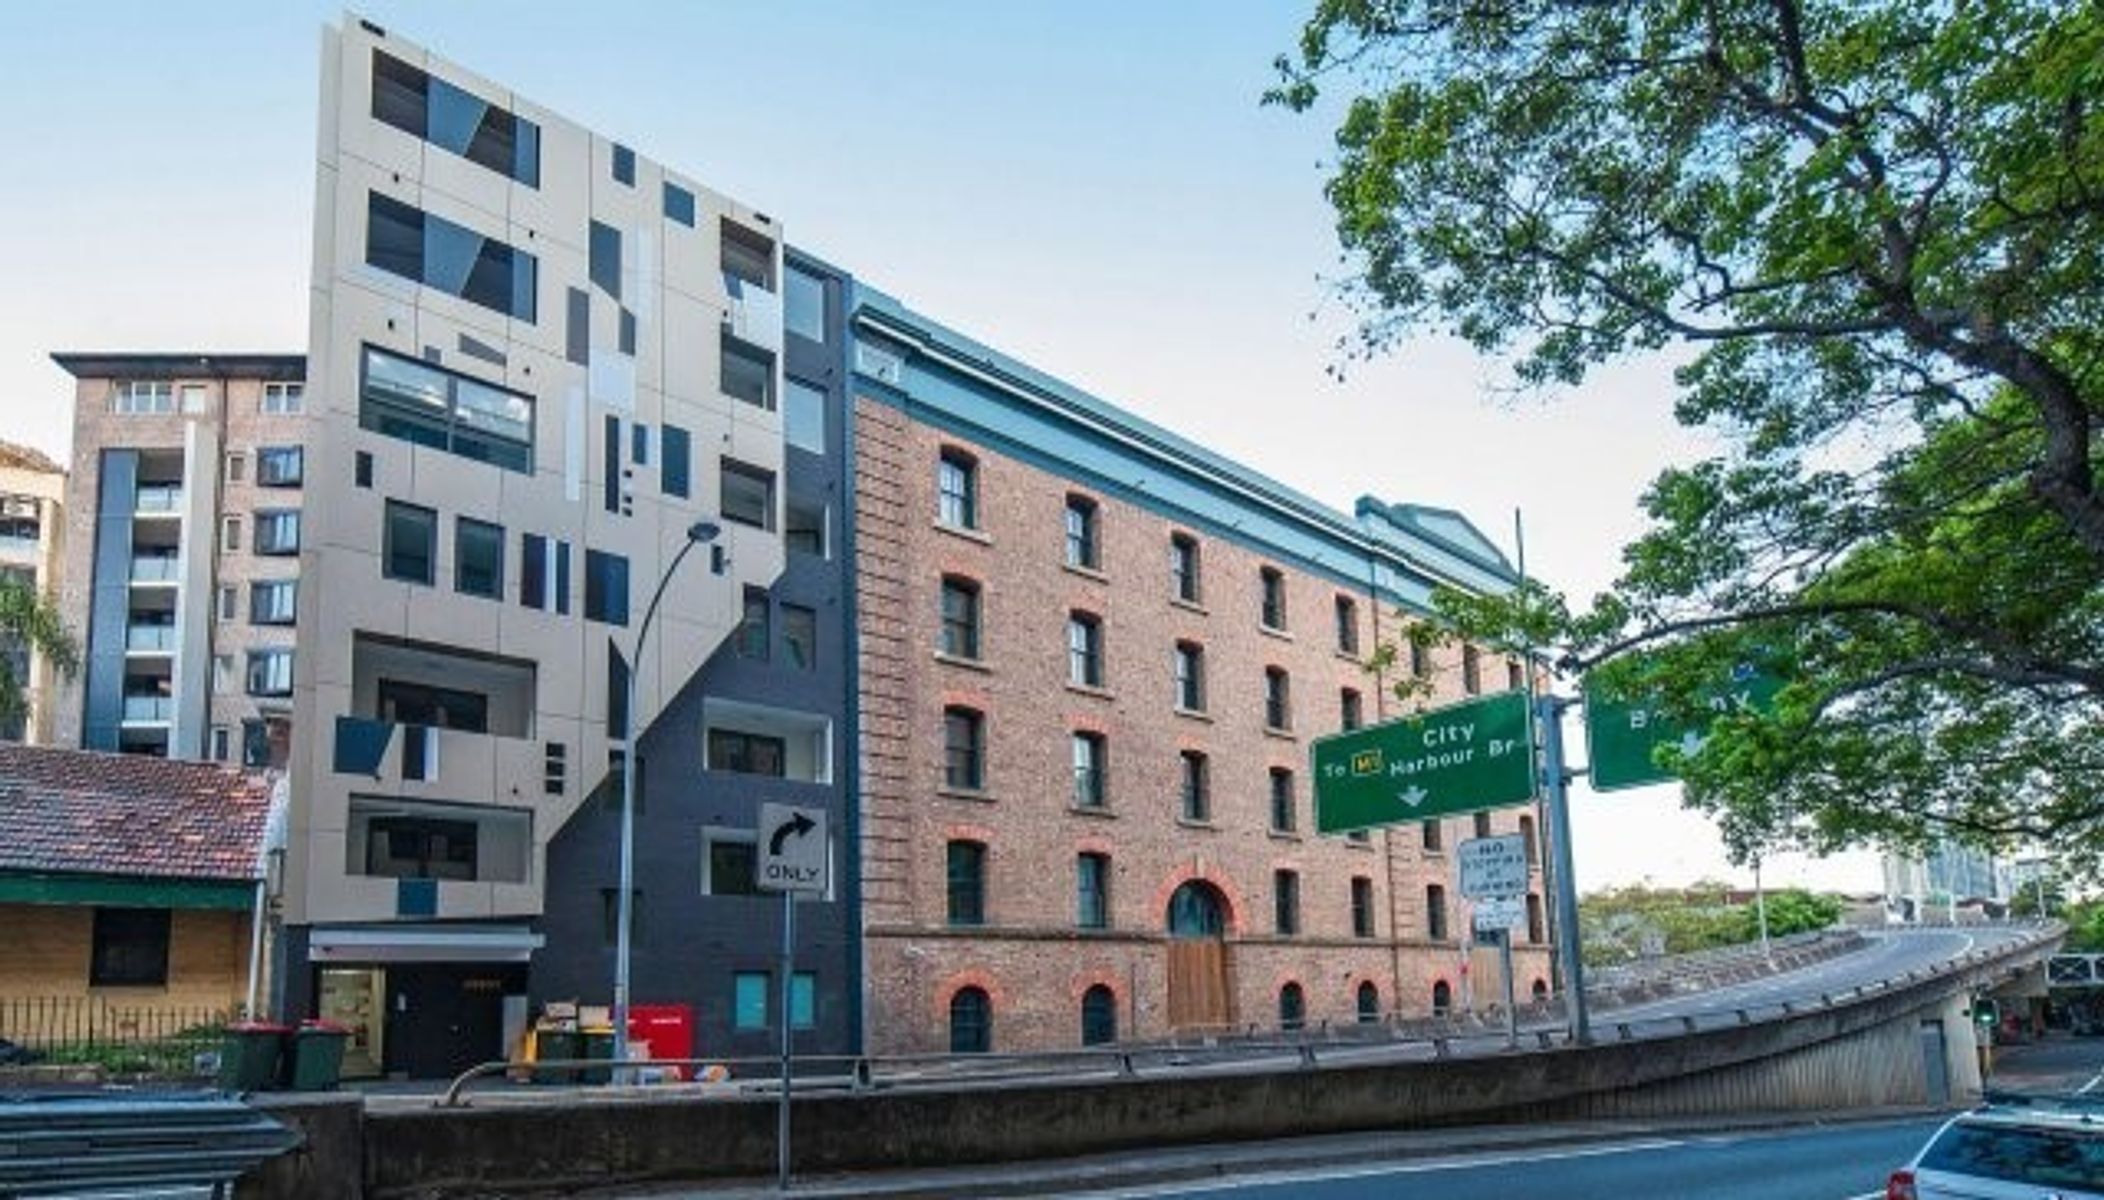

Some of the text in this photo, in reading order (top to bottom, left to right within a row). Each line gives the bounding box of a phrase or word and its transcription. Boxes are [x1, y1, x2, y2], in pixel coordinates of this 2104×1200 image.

[1423, 723, 1475, 747] City
[1323, 763, 1347, 778] To
[1390, 750, 1474, 777] Harbour
[1489, 739, 1515, 758] Br
[766, 865, 820, 881] ONLY
